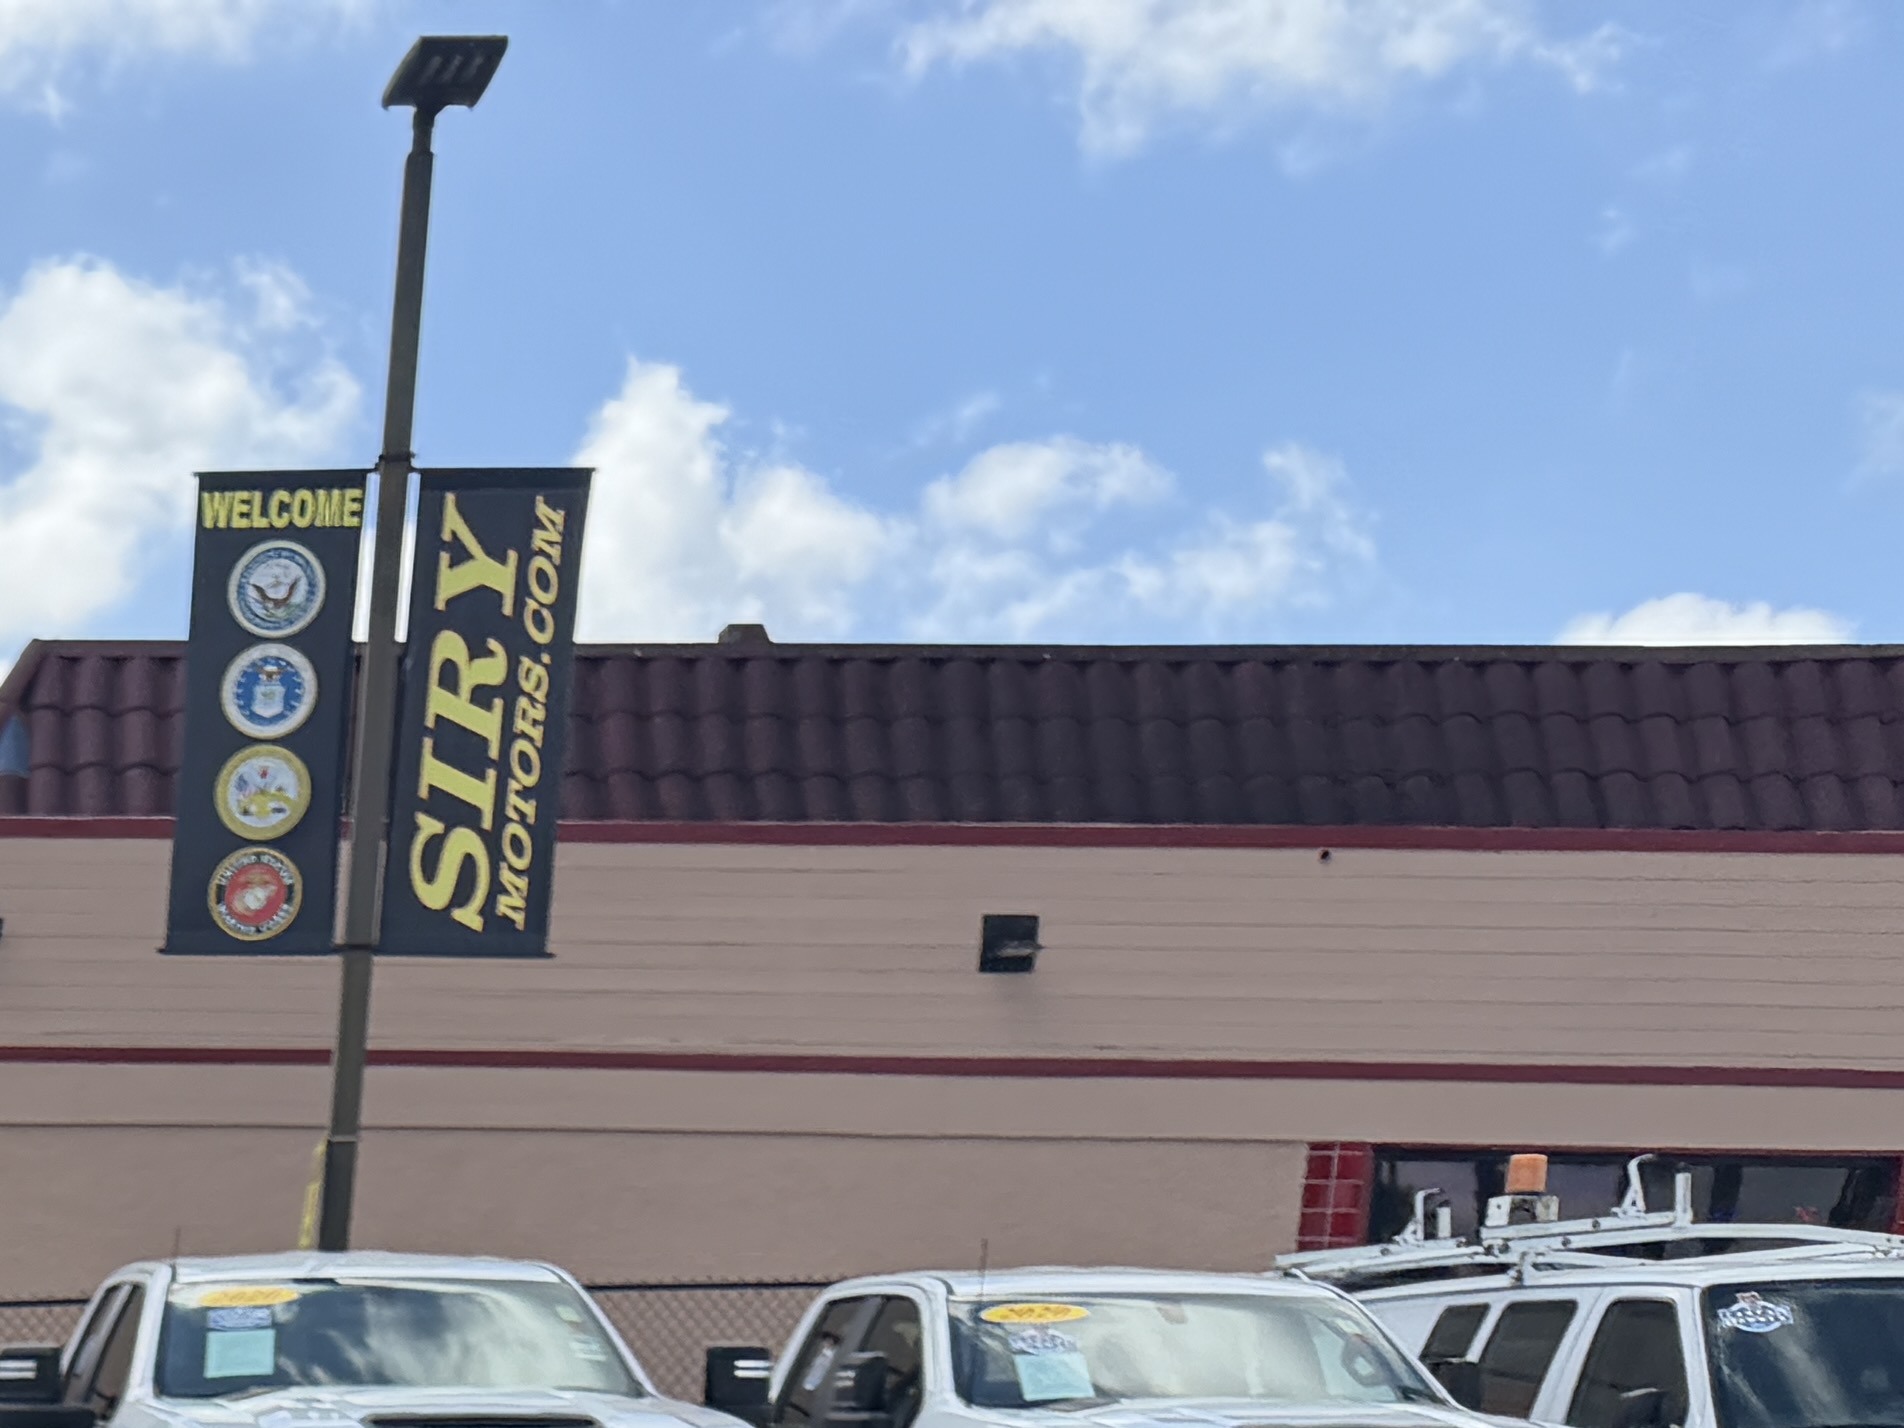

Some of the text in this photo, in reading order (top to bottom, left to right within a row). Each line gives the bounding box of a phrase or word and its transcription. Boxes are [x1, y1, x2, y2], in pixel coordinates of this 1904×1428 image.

[201, 488, 363, 529] WELCOME
[410, 491, 518, 933] SIRY
[496, 495, 566, 930] MOTORS.COM
